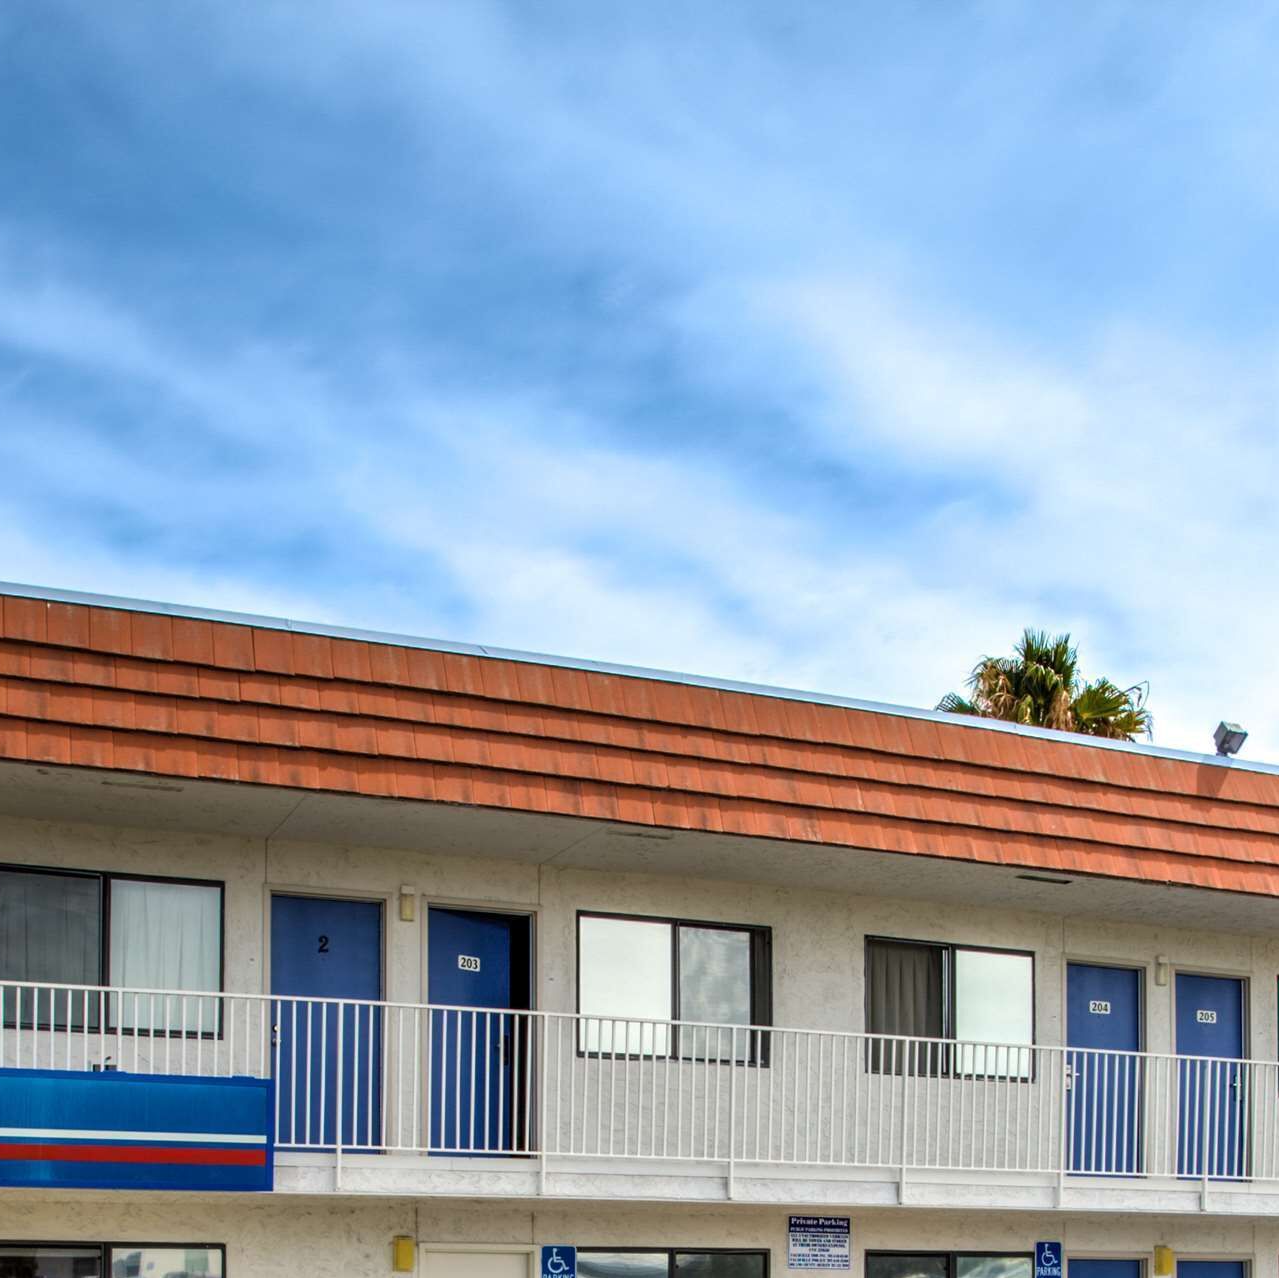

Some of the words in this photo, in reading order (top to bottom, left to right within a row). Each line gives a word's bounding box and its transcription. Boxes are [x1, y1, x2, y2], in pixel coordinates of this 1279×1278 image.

[318, 935, 329, 953] 2
[460, 957, 478, 970] 203
[1091, 1002, 1108, 1012] 204
[1199, 1012, 1214, 1021] 205
[791, 1217, 818, 1225] Private
[819, 1218, 848, 1227] Parking
[1036, 1266, 1061, 1276] PARKING
